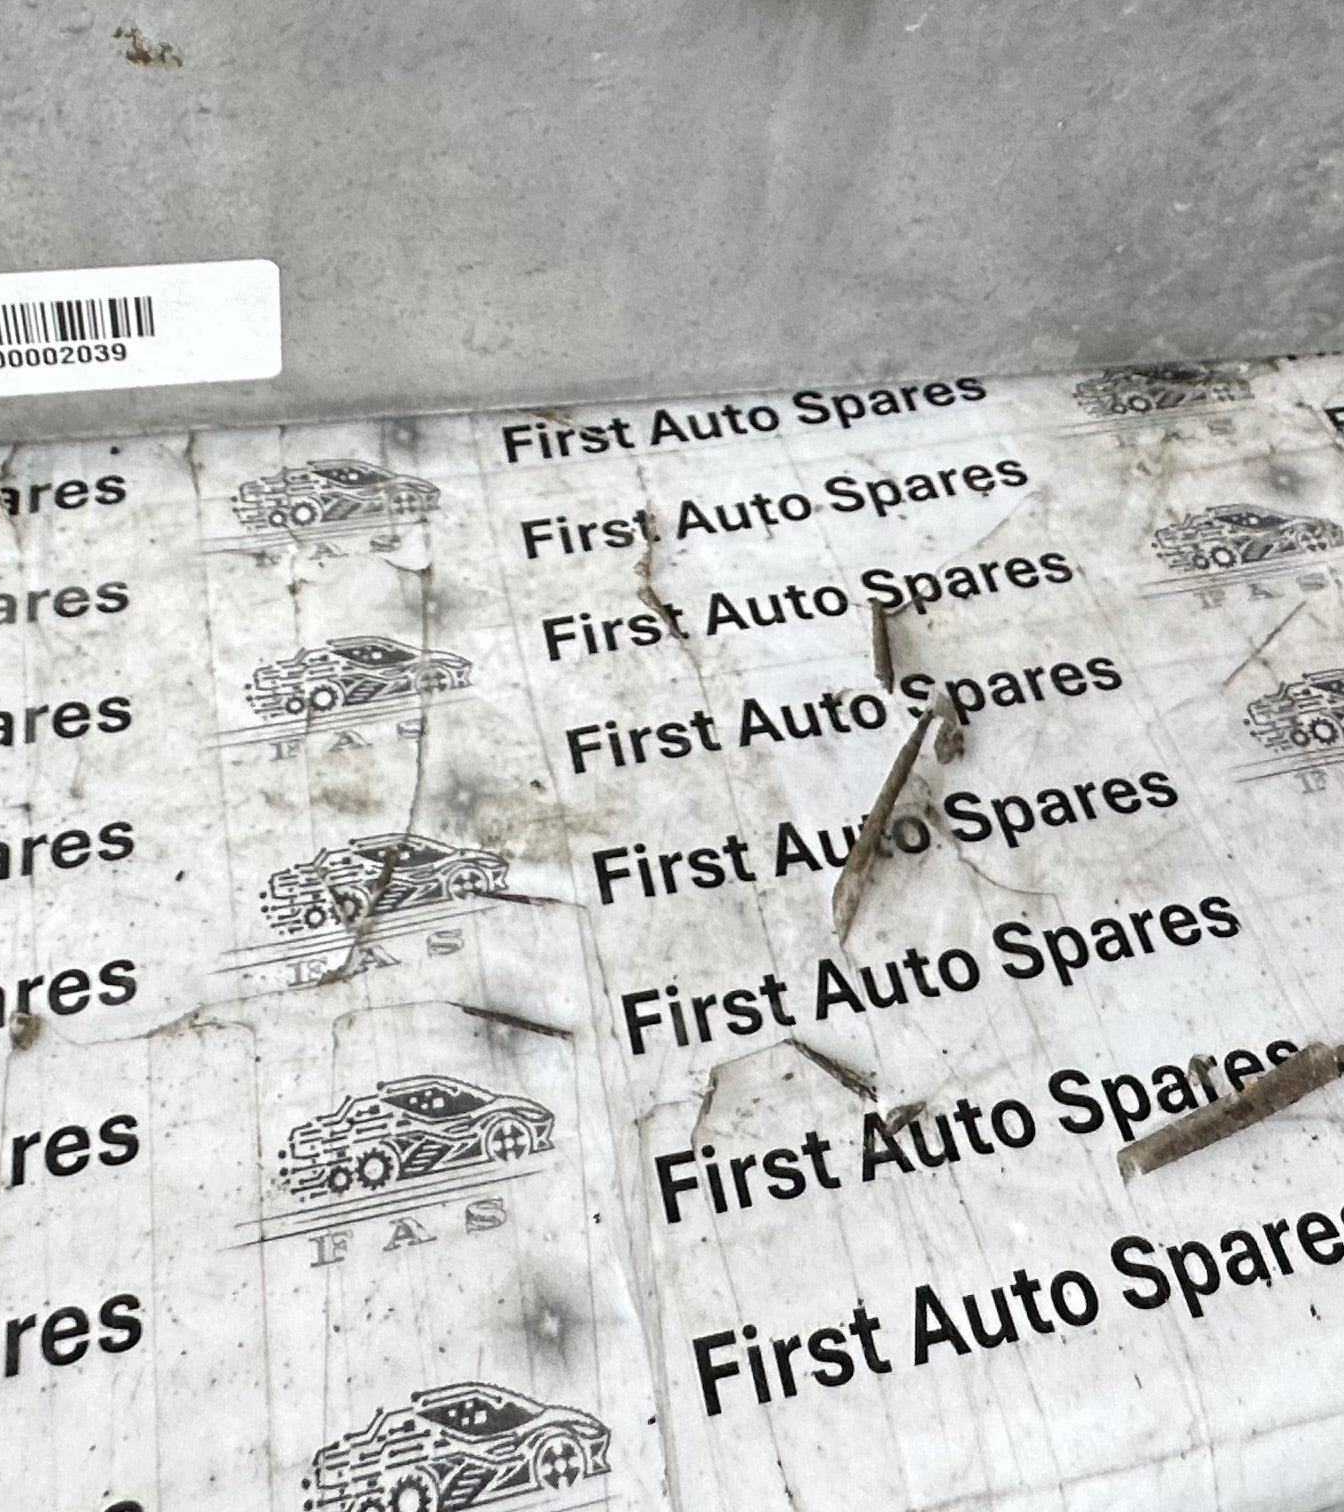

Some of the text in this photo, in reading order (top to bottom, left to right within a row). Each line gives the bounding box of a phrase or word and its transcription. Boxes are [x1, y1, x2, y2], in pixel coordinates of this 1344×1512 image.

[502, 375, 988, 464] First Auto Spares
[520, 457, 1029, 559] First Auto Spares
[542, 550, 1074, 662] First Auto Spares
[565, 710, 721, 774] First
[737, 691, 887, 747] Auto
[591, 769, 1180, 904] First Auo Spares
[620, 895, 1241, 1055] First Auto Spares
[654, 1130, 842, 1224] First
[860, 1097, 1037, 1183] Auto
[693, 1308, 892, 1417] First
[913, 1269, 1100, 1366] Auto
